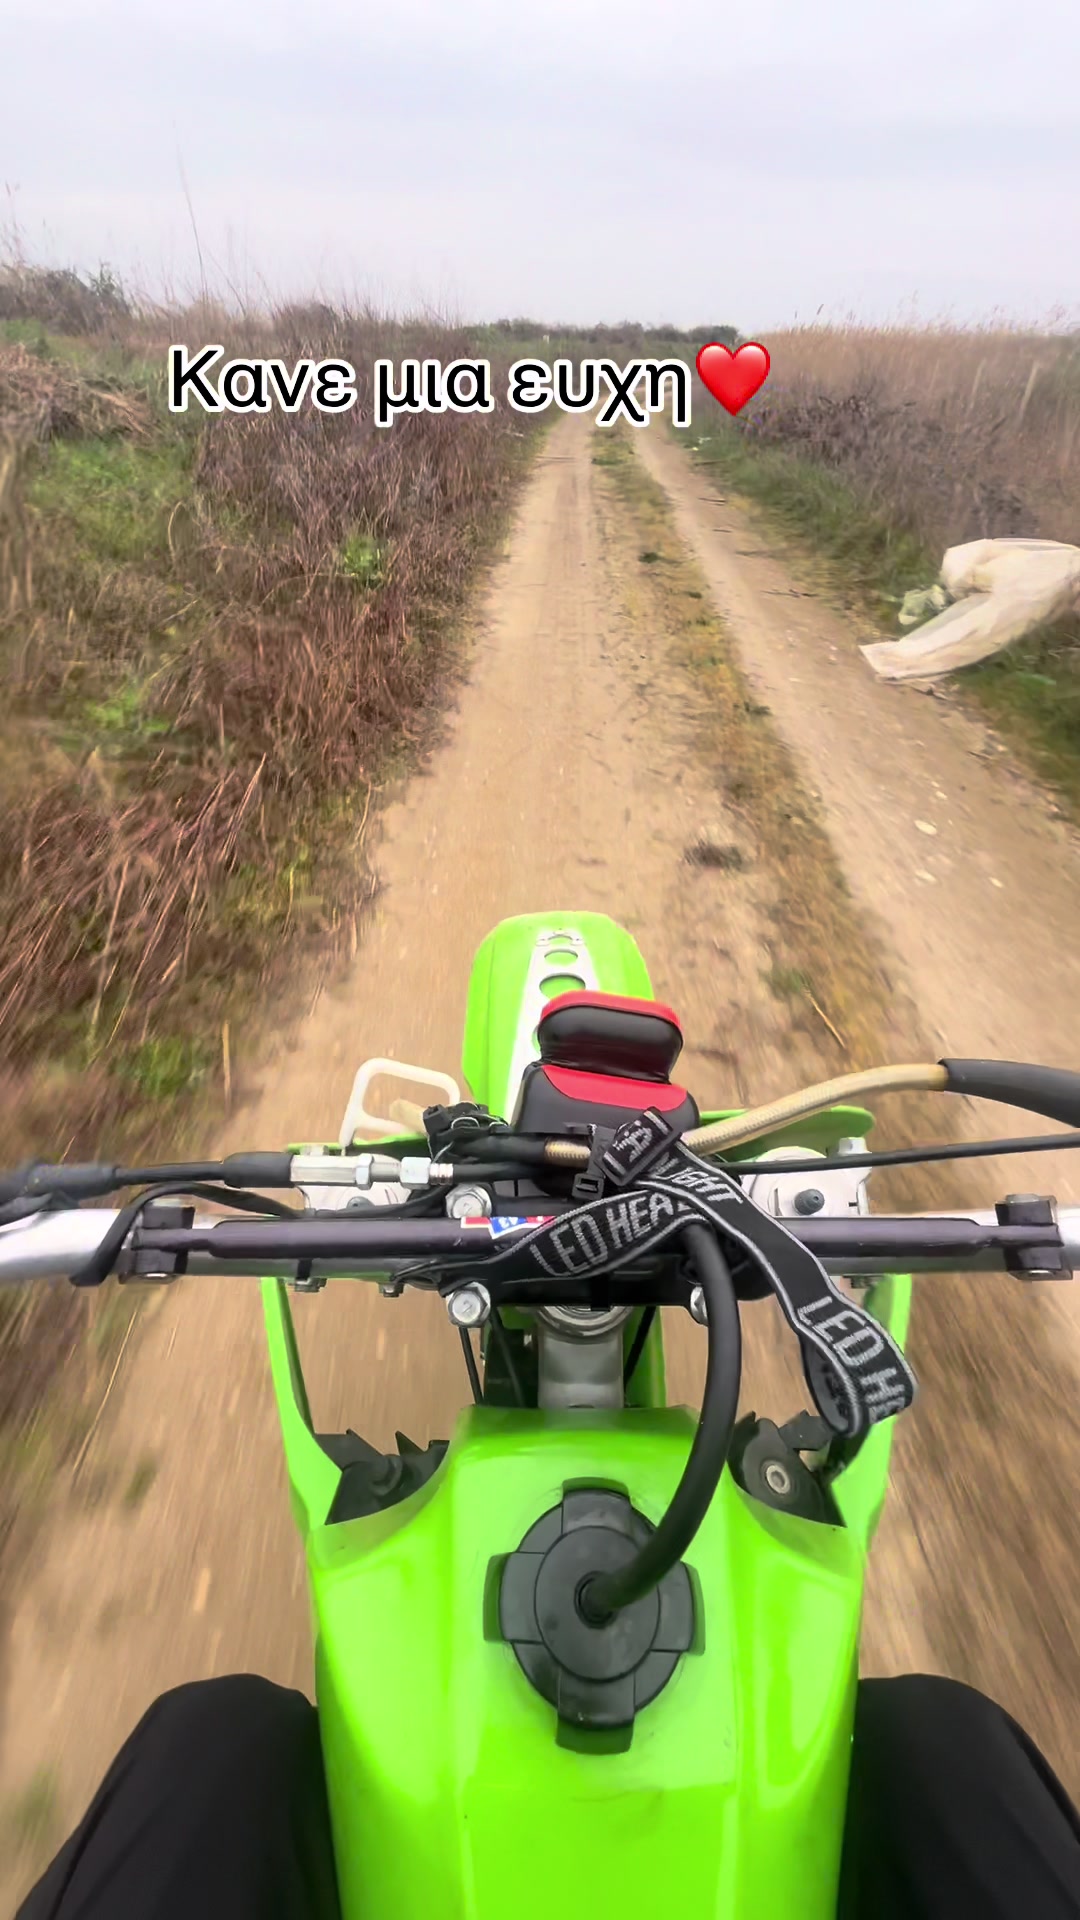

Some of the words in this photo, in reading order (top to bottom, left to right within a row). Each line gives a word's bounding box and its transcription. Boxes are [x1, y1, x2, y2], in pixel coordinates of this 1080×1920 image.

[530, 1212, 608, 1277] LED
[606, 1192, 691, 1249] HEA
[797, 1296, 884, 1366] LED
